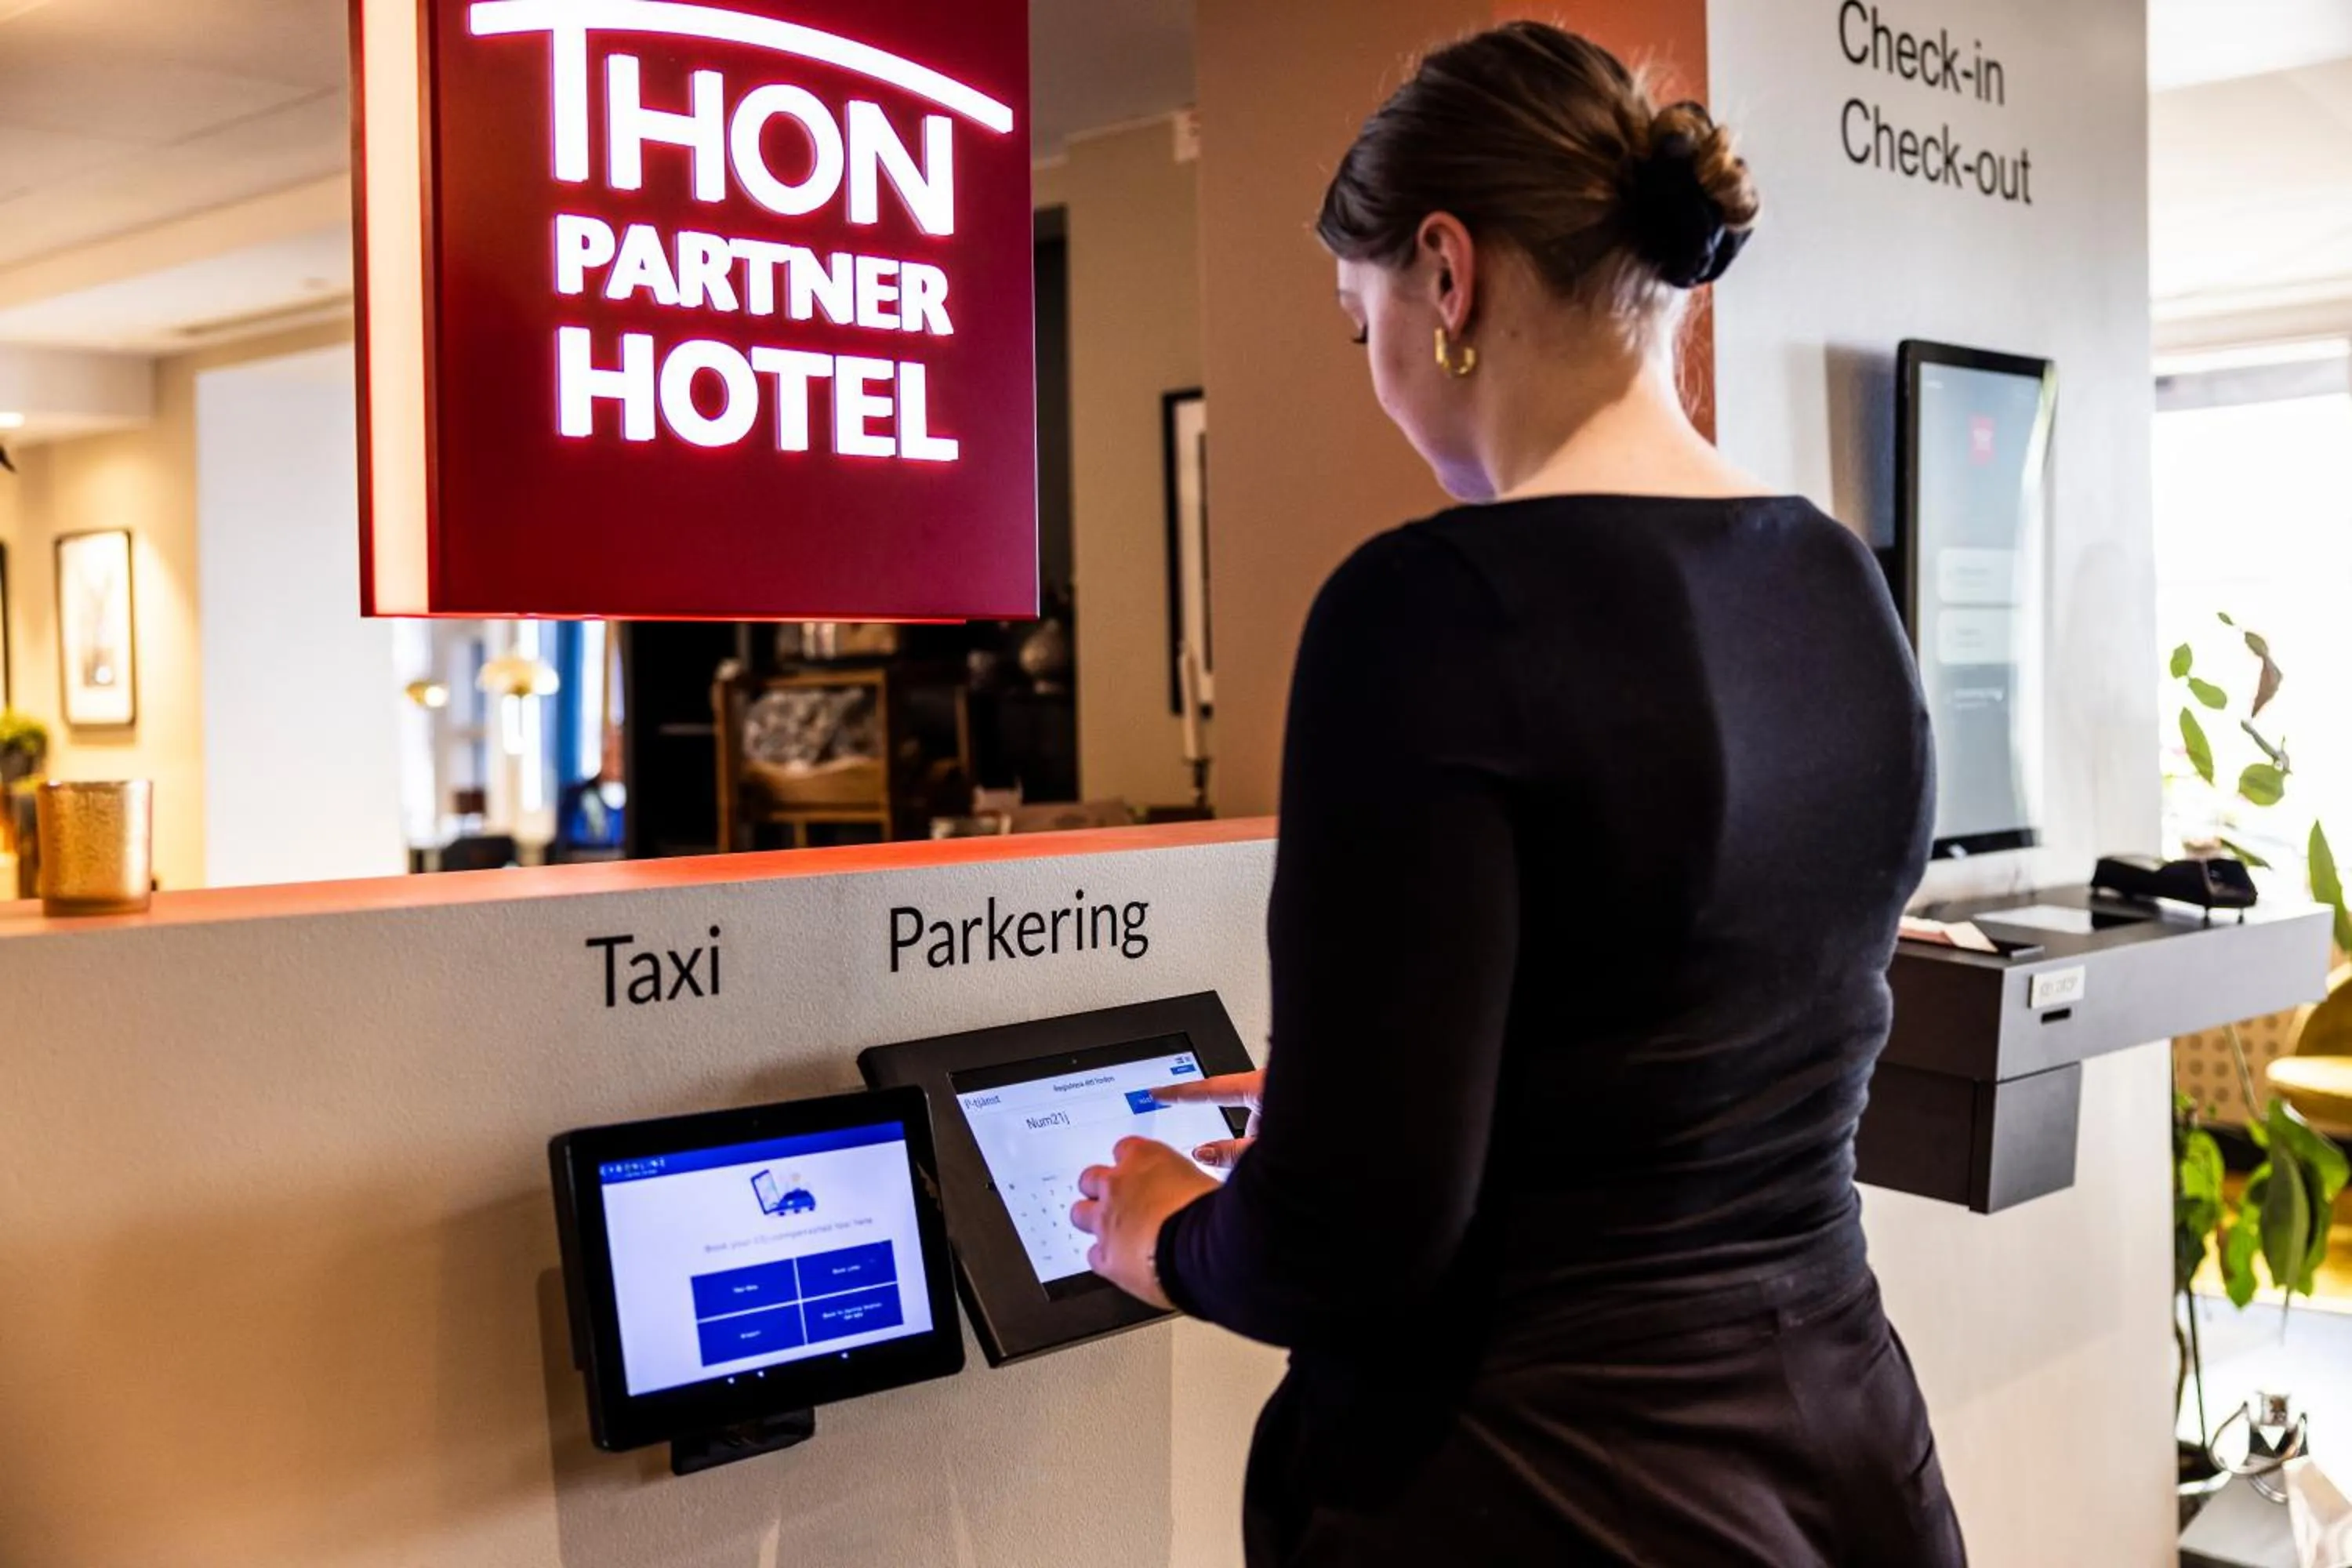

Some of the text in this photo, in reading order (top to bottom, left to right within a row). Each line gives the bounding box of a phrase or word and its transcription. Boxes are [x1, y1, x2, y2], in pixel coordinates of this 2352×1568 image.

[1838, 0, 2005, 107] Check-in
[469, 0, 1014, 236] THON
[1841, 98, 2032, 205] Check-out
[555, 213, 954, 336] PARTNER
[557, 325, 959, 461] HOTEL
[585, 925, 721, 1008] Taxi
[889, 889, 1149, 972] Parkering
